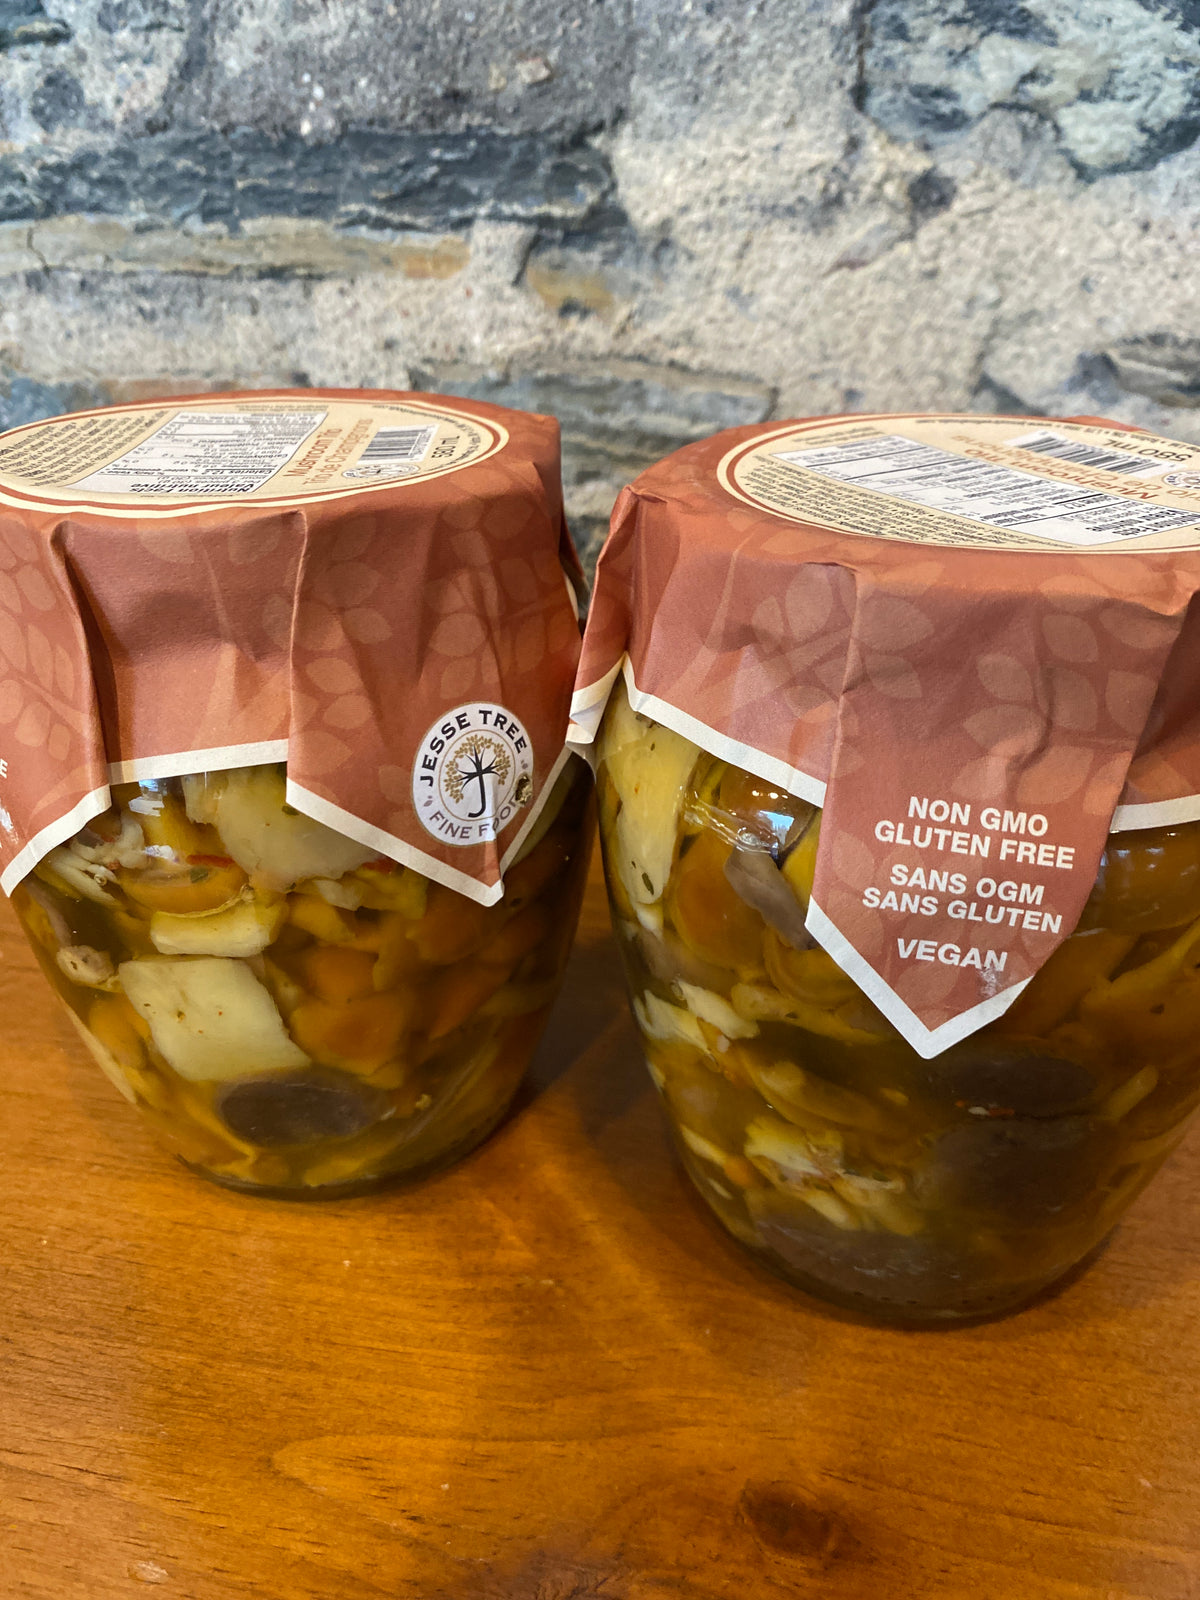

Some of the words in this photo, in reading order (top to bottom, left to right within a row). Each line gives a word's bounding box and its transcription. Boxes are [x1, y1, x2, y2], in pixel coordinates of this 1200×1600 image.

[1138, 448, 1192, 462] 580
[1010, 461, 1159, 500] Mushroom
[419, 712, 471, 787] JESSE
[478, 709, 528, 754] TREE
[429, 810, 473, 839] FINE
[907, 796, 971, 826] NON
[979, 807, 1049, 837] GMO
[874, 820, 991, 858] GLUTEN
[999, 838, 1076, 870] FREE
[889, 863, 968, 895] SANS
[975, 877, 1045, 906] OGM
[862, 886, 939, 916] SANS
[947, 900, 1063, 934] GLUTEN
[896, 937, 1008, 972] VEGAN
